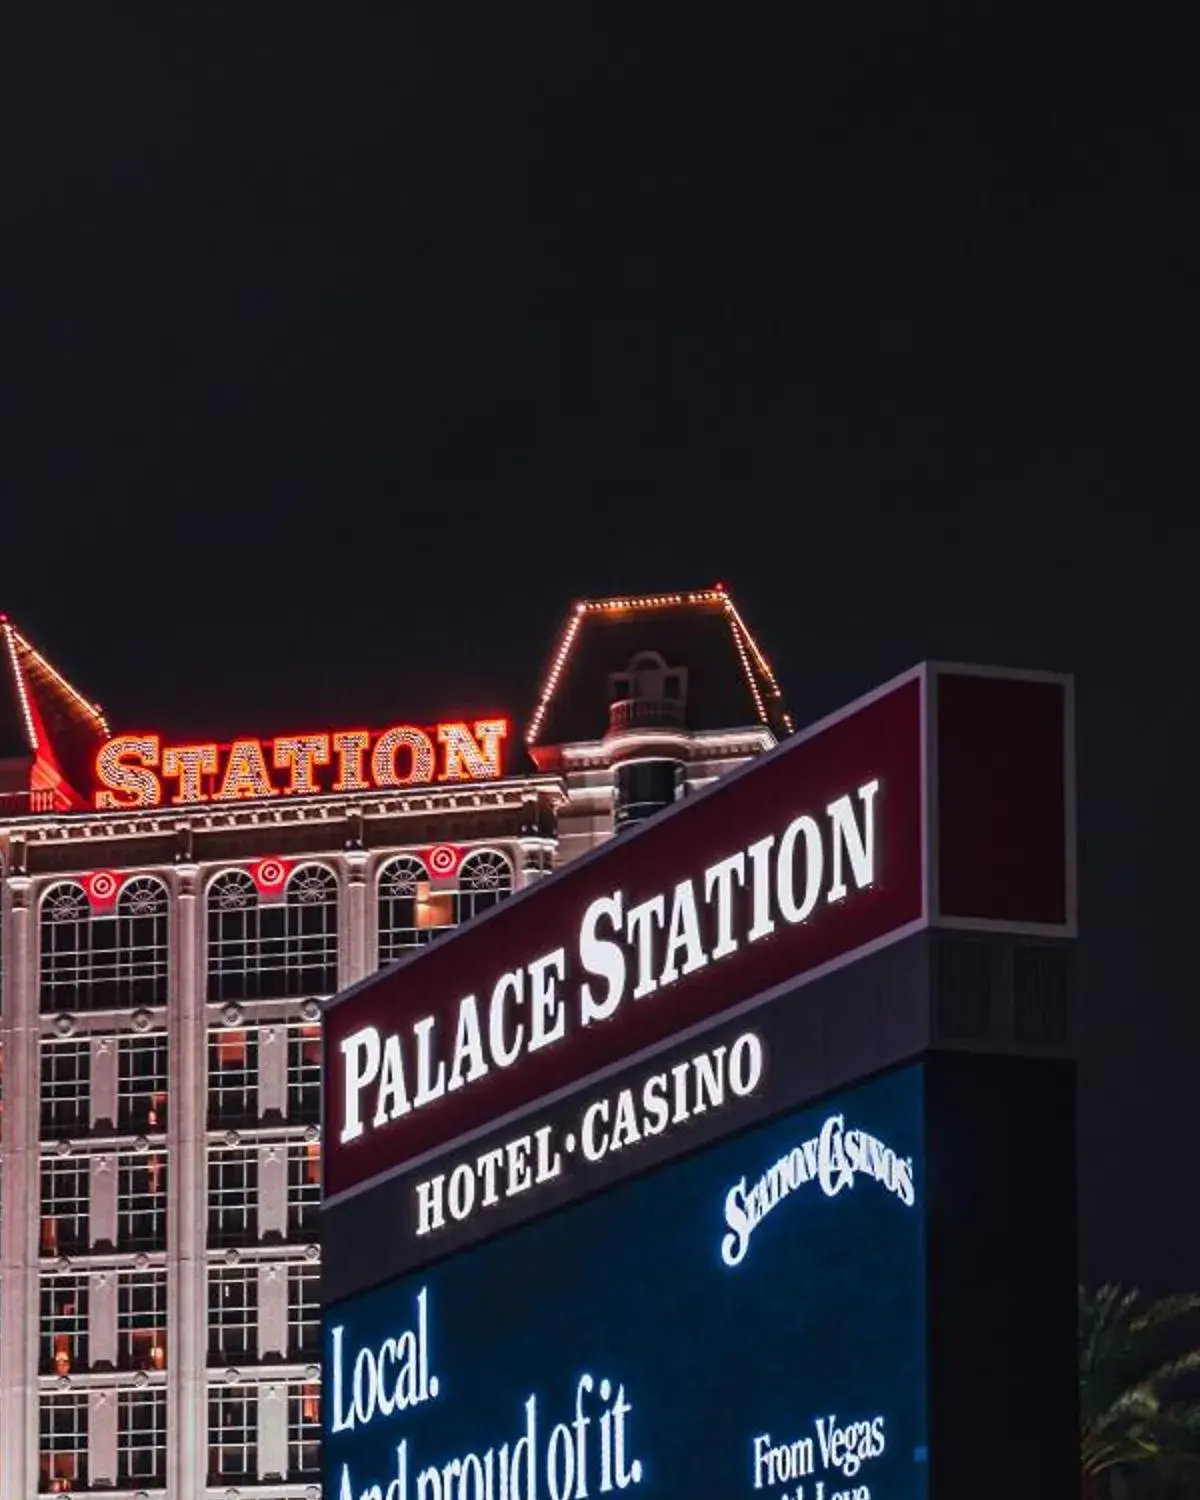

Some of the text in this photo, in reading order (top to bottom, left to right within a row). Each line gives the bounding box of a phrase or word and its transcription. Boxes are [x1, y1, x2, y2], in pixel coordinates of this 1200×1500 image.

[94, 718, 508, 809] STATION
[340, 779, 880, 1145] PALACE STATION
[330, 1285, 440, 1434] Local.
[599, 1378, 643, 1492] it.
[753, 1413, 886, 1489] From Vegas
